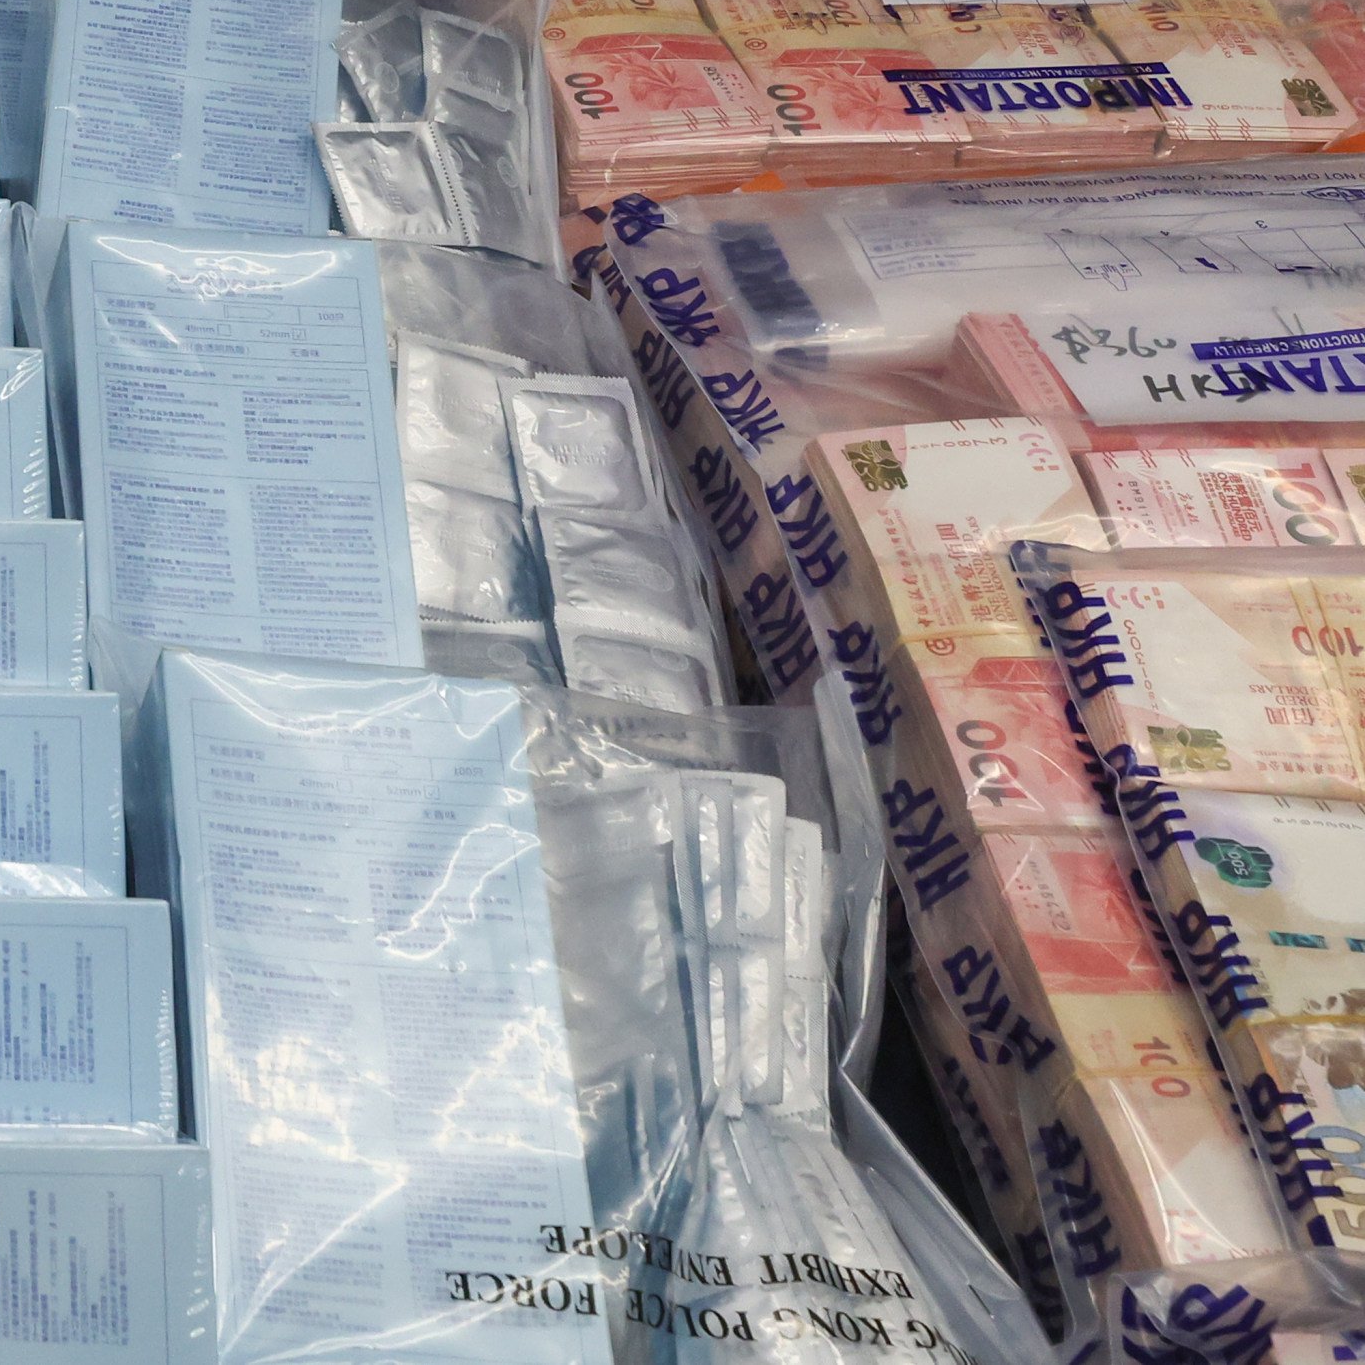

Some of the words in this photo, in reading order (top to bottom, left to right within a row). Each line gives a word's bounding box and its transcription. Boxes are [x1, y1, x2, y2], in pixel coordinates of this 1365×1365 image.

[565, 72, 620, 120] 100
[767, 84, 822, 136] 100
[899, 77, 1194, 115] IMPORTANT
[701, 369, 785, 447] HKP
[1265, 463, 1340, 545] 100
[764, 473, 846, 589] HKP
[882, 777, 971, 912] HKP
[1228, 852, 1250, 876] 500
[444, 1271, 599, 1316] FORCE
[759, 1253, 913, 1300] EXHIBIT
[772, 1308, 894, 1347] KONG
